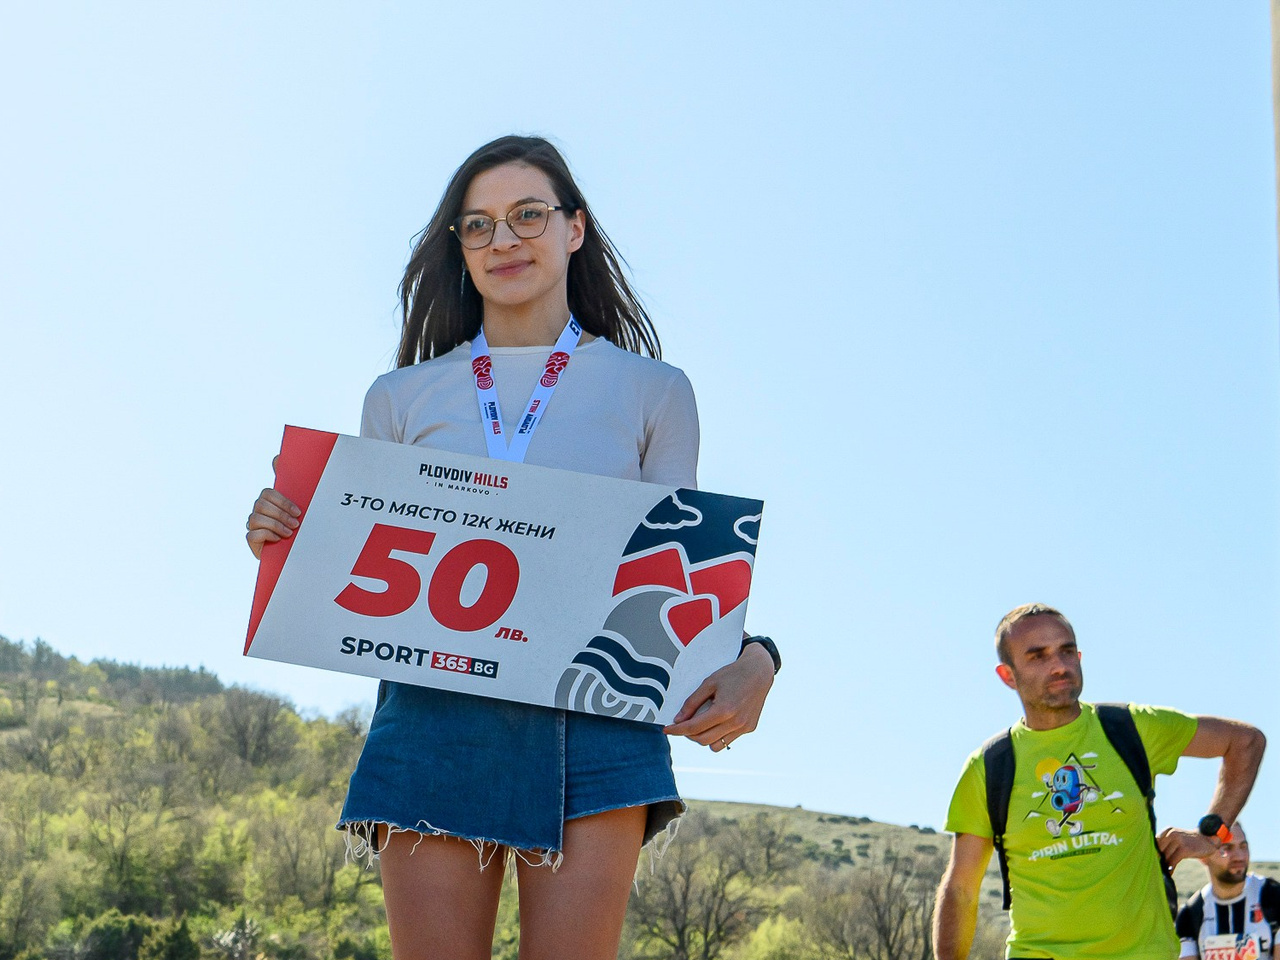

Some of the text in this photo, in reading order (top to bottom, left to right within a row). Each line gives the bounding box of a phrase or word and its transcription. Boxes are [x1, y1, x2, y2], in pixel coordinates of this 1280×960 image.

[419, 463, 509, 490] PLOVDIV HILLS
[448, 484, 490, 496] MARKOVO
[340, 493, 385, 511] 3-ТО
[389, 501, 457, 523] МЯСТО
[495, 518, 556, 540] ЖЕНИ
[333, 523, 529, 643] 50 лв.
[340, 636, 430, 667] SPORT
[1031, 840, 1068, 861] PIRIN
[1072, 832, 1118, 849] ULTRA
